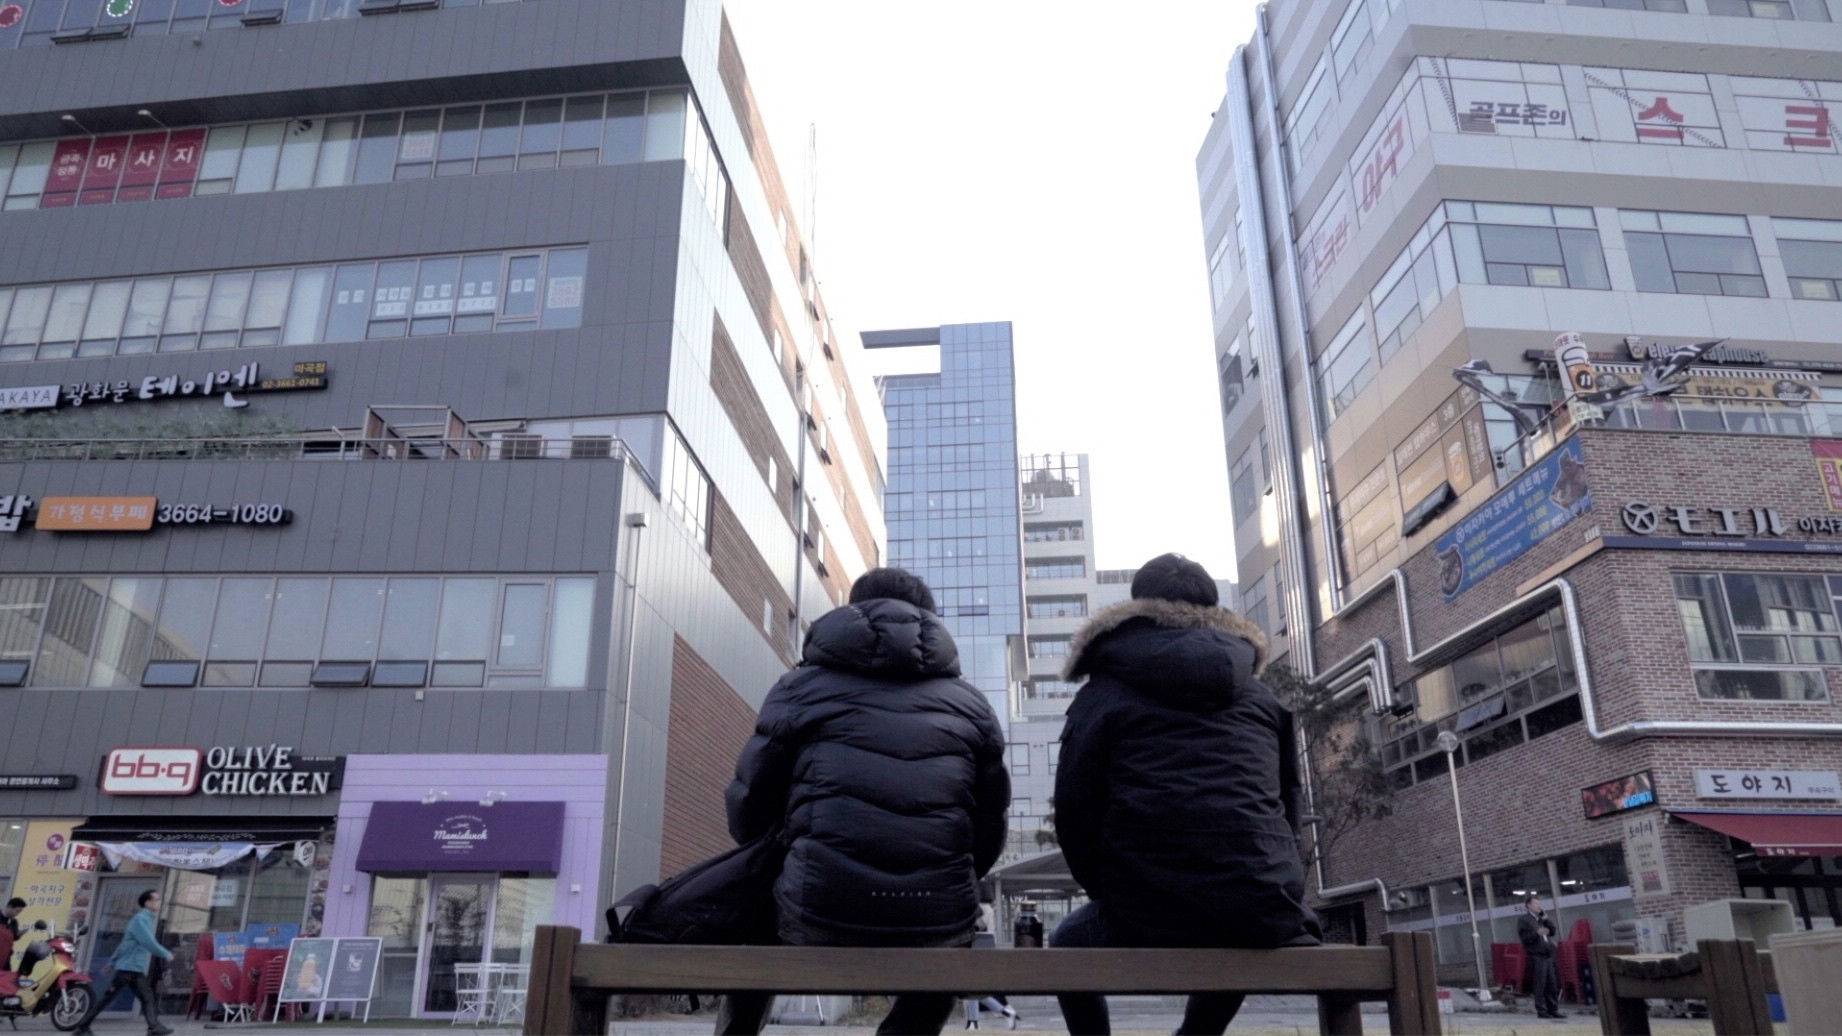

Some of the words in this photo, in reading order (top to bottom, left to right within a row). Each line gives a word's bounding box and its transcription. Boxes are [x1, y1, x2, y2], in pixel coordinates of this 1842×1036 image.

[1469, 101, 1566, 126] 골프존의
[158, 503, 284, 524] 3664-1080
[206, 744, 293, 770] OLIVE
[201, 772, 331, 796] CHICKEN
[1711, 774, 1792, 794] 도야지
